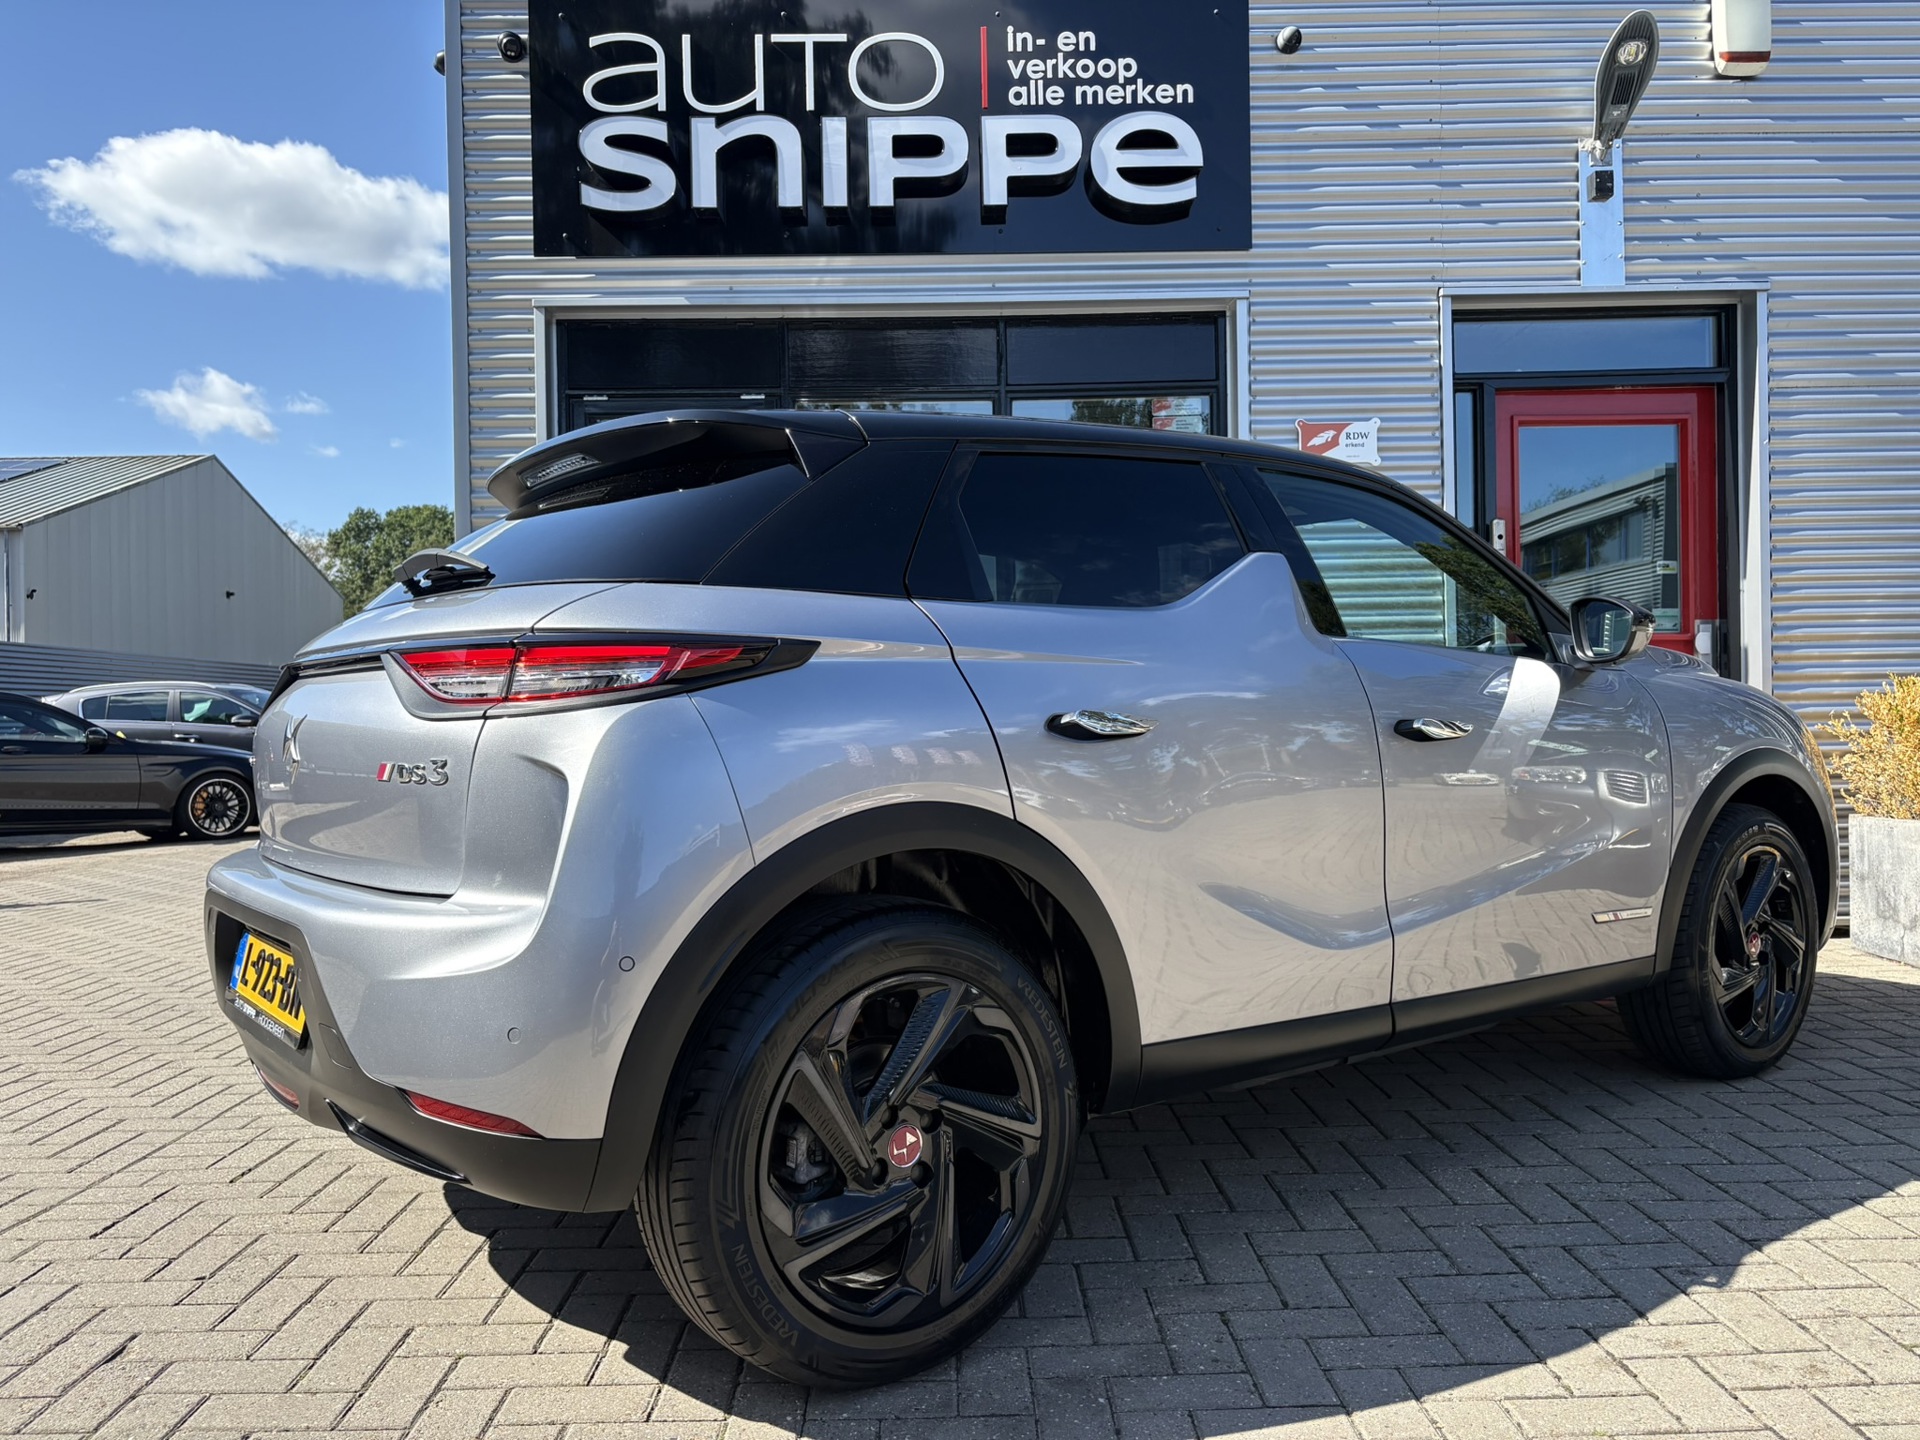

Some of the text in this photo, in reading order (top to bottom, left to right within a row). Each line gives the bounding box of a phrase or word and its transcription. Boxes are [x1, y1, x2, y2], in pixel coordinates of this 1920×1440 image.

[1007, 25, 1096, 52] in- en
[1007, 53, 1138, 84] verkoop
[1008, 78, 1194, 106] alle merken
[1345, 432, 1370, 440] RDW
[1017, 976, 1068, 1069] VREDESTEIN
[731, 1243, 799, 1347] VREDESTEIN
